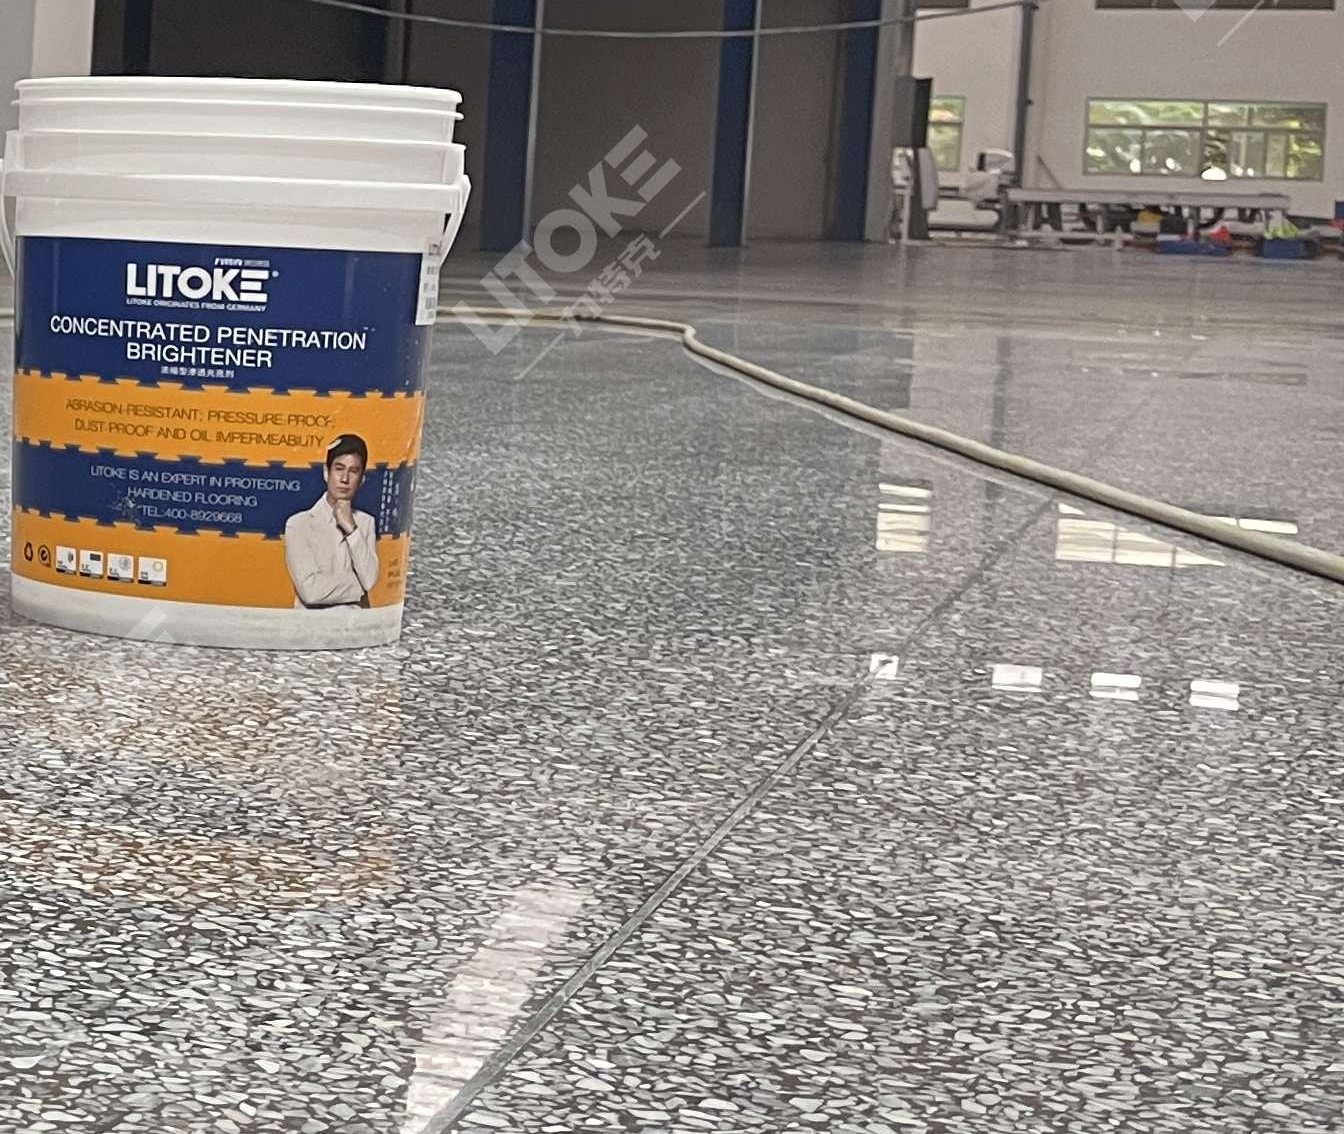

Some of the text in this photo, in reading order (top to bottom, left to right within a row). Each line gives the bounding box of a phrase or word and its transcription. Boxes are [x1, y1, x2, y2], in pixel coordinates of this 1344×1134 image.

[127, 263, 269, 302] LITOKE
[126, 298, 152, 306] LITOKE
[226, 304, 266, 312] GERMANY
[50, 315, 366, 350] CONCENTRATED PENETRATION
[127, 342, 272, 368] BRIGHTENER
[157, 426, 186, 440] AND
[190, 428, 212, 442] OIL
[216, 431, 324, 447] IMPERMEABILITY
[91, 465, 301, 491] LITOKE IS AN EXPERT IN PROTECTING
[127, 486, 258, 507] HARDENED FLOORING
